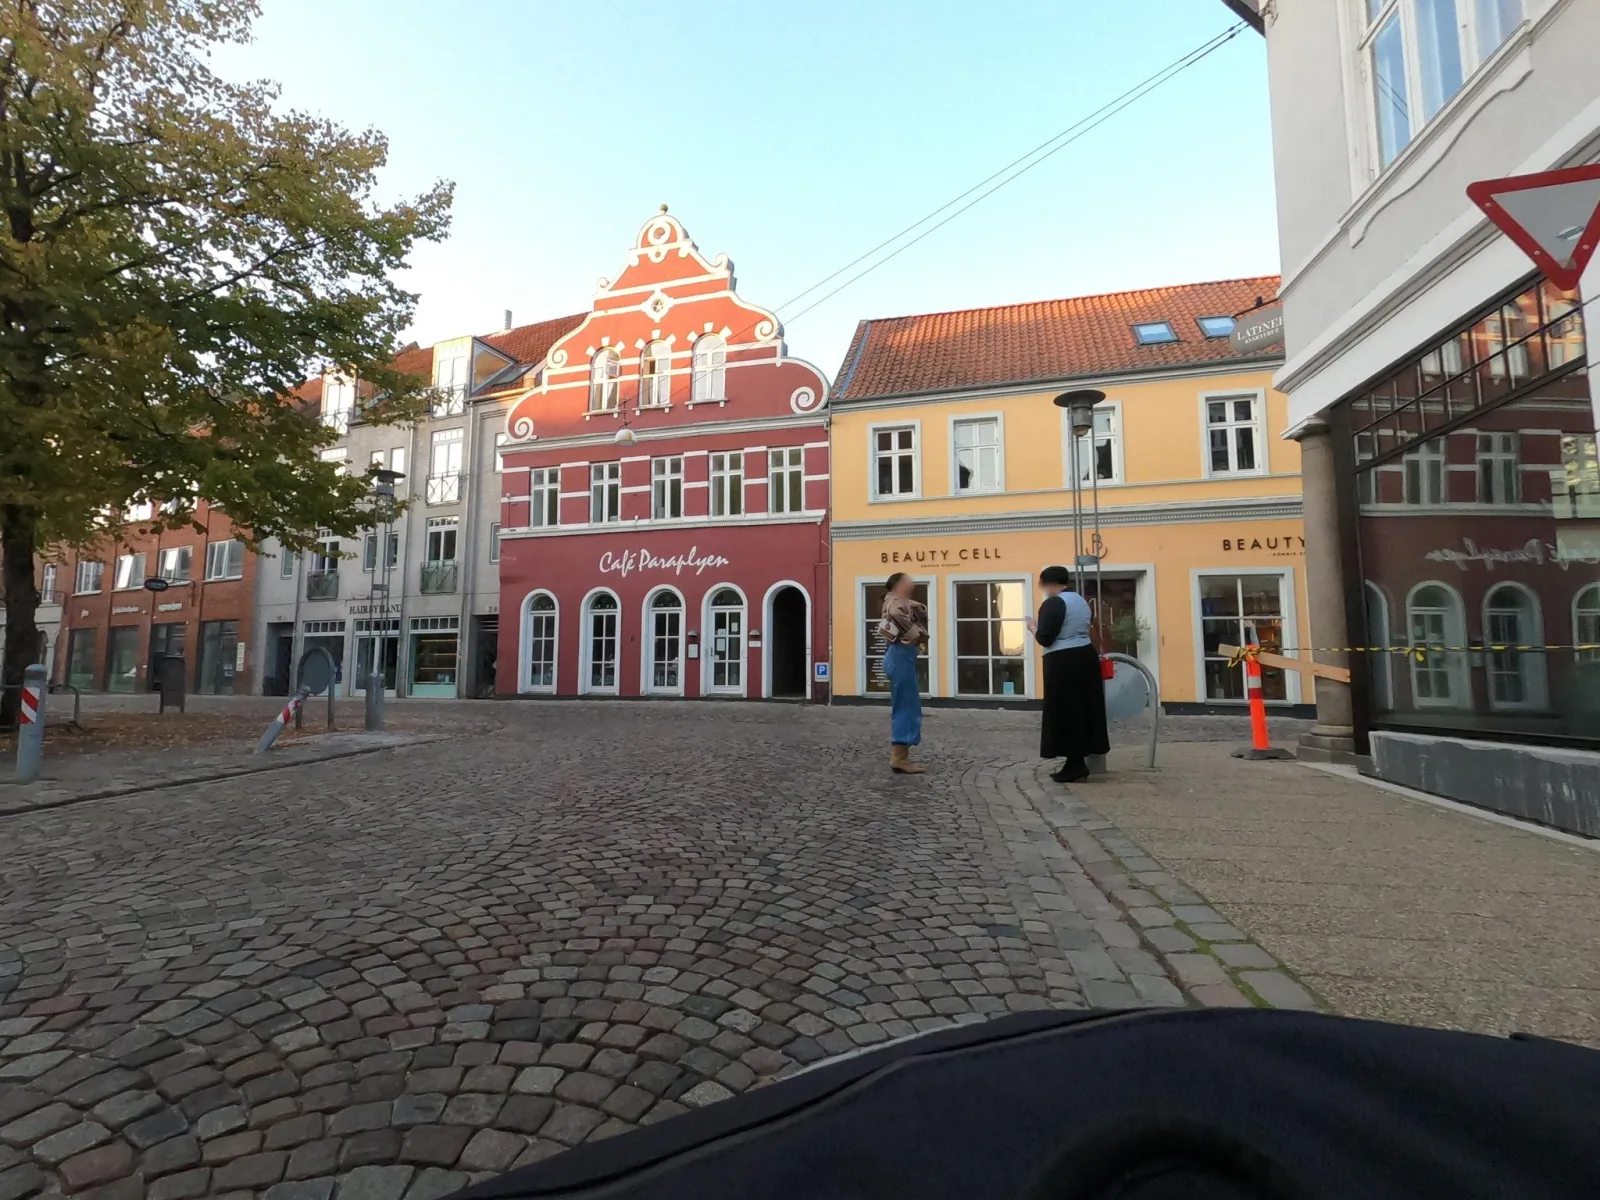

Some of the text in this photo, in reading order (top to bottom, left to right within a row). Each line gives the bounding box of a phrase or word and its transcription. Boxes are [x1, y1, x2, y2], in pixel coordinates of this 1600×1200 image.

[1222, 535, 1305, 551] BEAUTY
[599, 545, 729, 578] Café Paraplyen
[881, 547, 1001, 563] BEAUTY CELL
